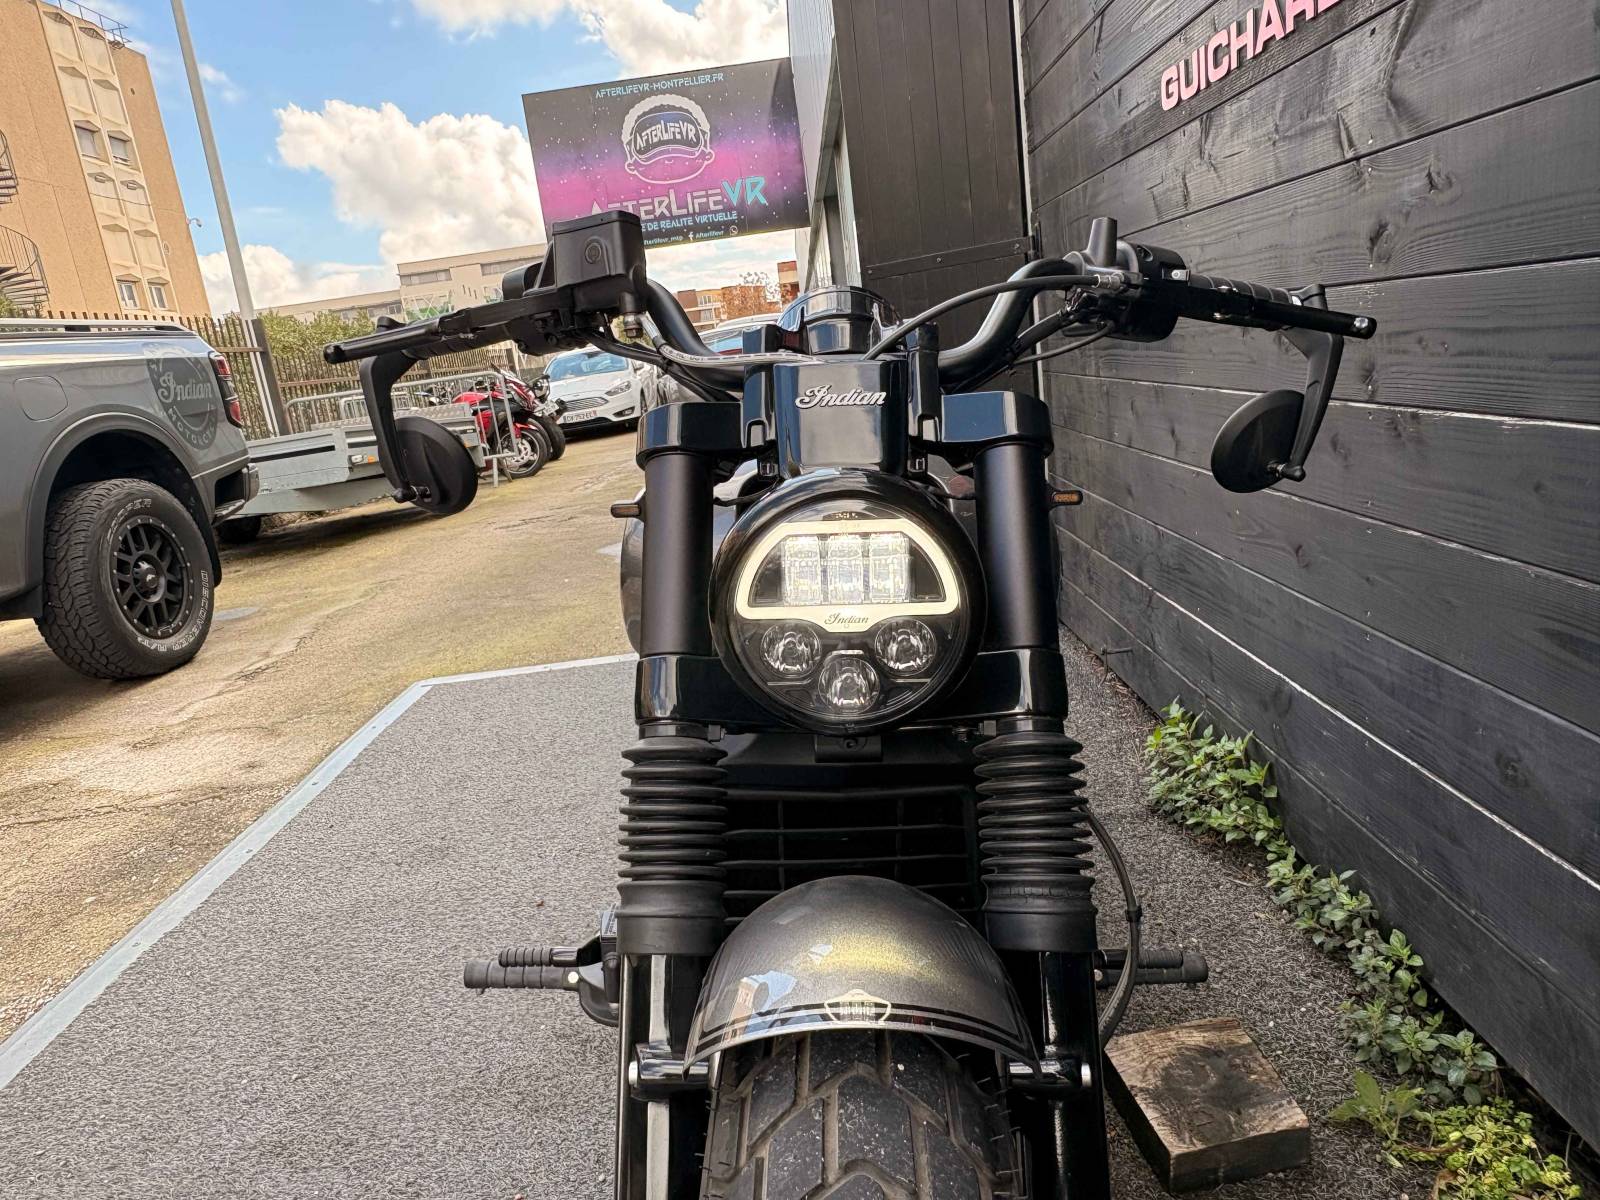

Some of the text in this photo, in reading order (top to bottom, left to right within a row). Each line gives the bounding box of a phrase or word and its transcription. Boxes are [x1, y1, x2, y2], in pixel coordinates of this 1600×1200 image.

[595, 72, 724, 98] AFTERLIFEVR-MONTPELLIER.FR
[647, 222, 659, 231] DE
[695, 211, 738, 224] VIRTUELLE
[158, 371, 213, 403] Indian
[795, 384, 887, 409] Indian
[173, 570, 209, 651] DISCOVERER
[824, 613, 869, 625] Indian
